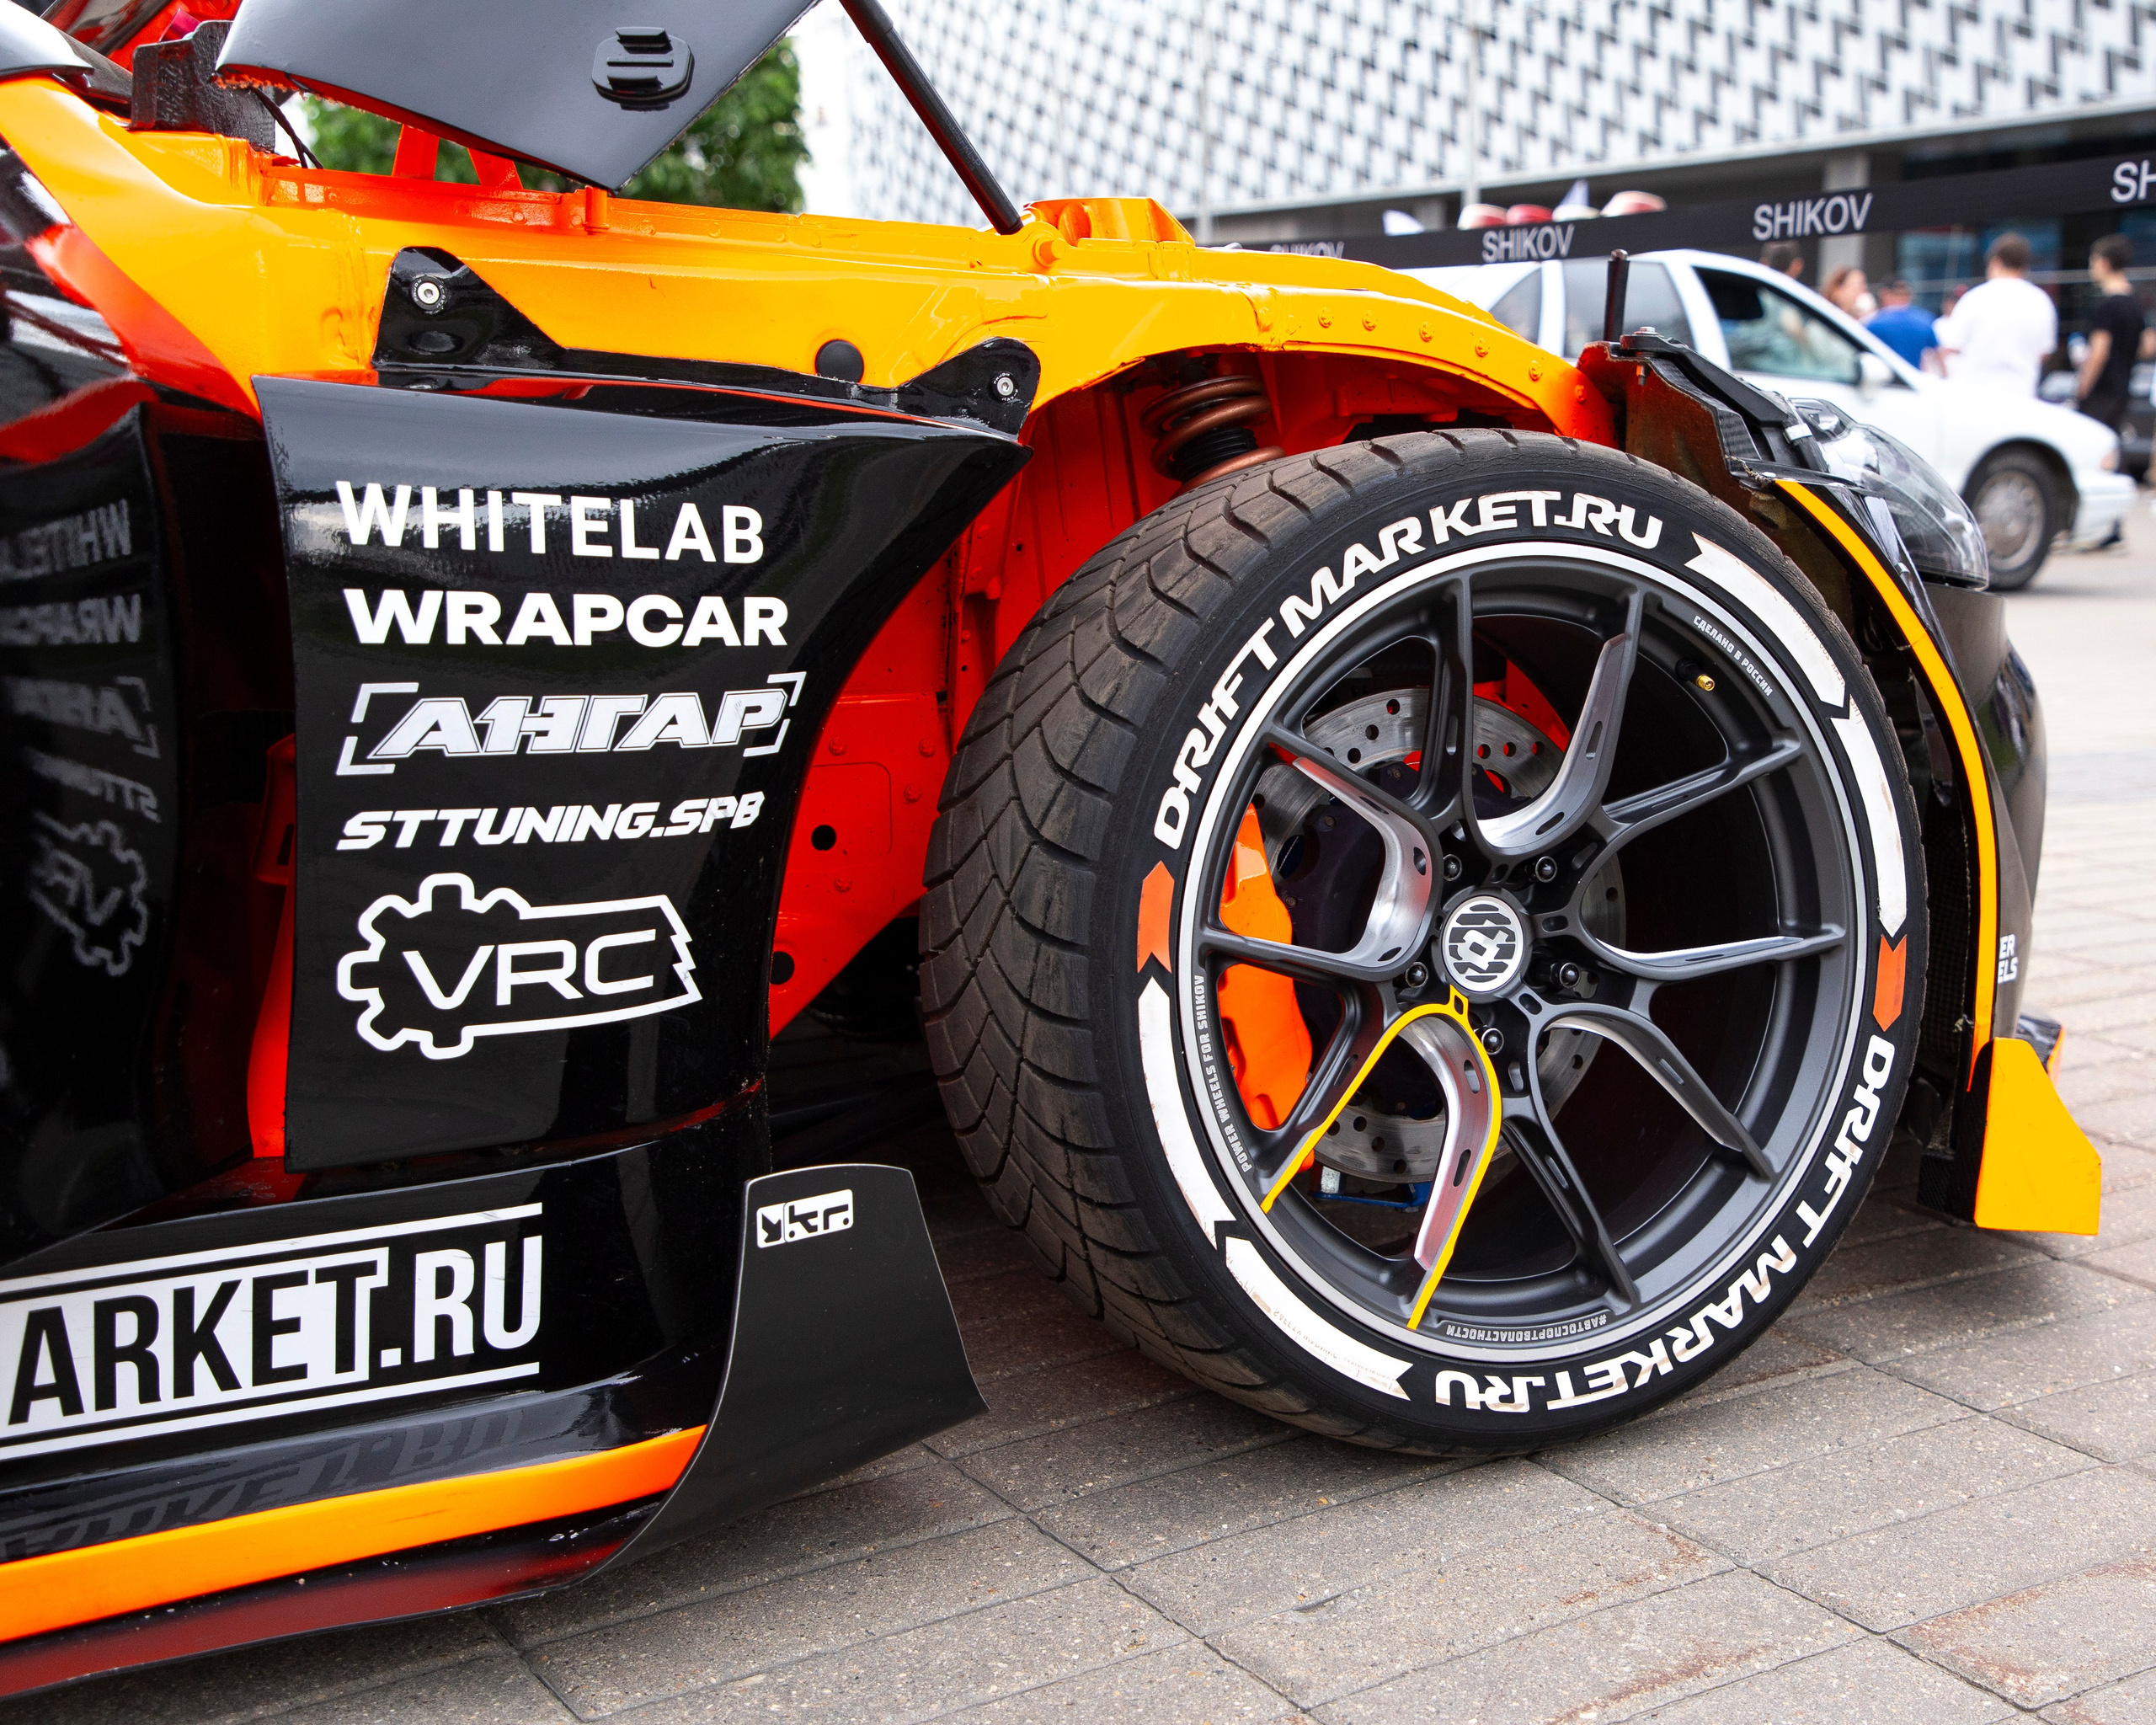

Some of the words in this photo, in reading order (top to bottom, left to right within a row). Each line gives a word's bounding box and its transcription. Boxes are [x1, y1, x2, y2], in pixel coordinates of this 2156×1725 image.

[1481, 223, 1575, 264] SHIKOV
[1752, 192, 1873, 241] SHIKOV
[336, 480, 764, 563] WHITELAB
[344, 588, 788, 648] WRAPCAR
[1153, 617, 1278, 850] DRIFT
[1278, 490, 1663, 638] MARKET.RU
[1693, 615, 1735, 654] СДЕЛАНО
[1733, 649, 1742, 660] В
[1741, 657, 1773, 697] РОССИИ
[336, 791, 766, 851] STTUNING.SPB
[402, 927, 657, 1010] VRC
[1193, 975, 1208, 1029] SHIKOV
[1199, 1032, 1214, 1062] FOR
[1205, 1065, 1230, 1123] WHEELS
[1224, 1124, 1252, 1172] POWER
[1795, 1034, 1896, 1249] DRIFT
[7, 1234, 542, 1427] ARKET.RU
[1435, 1233, 1798, 1413] MARKET.RU
